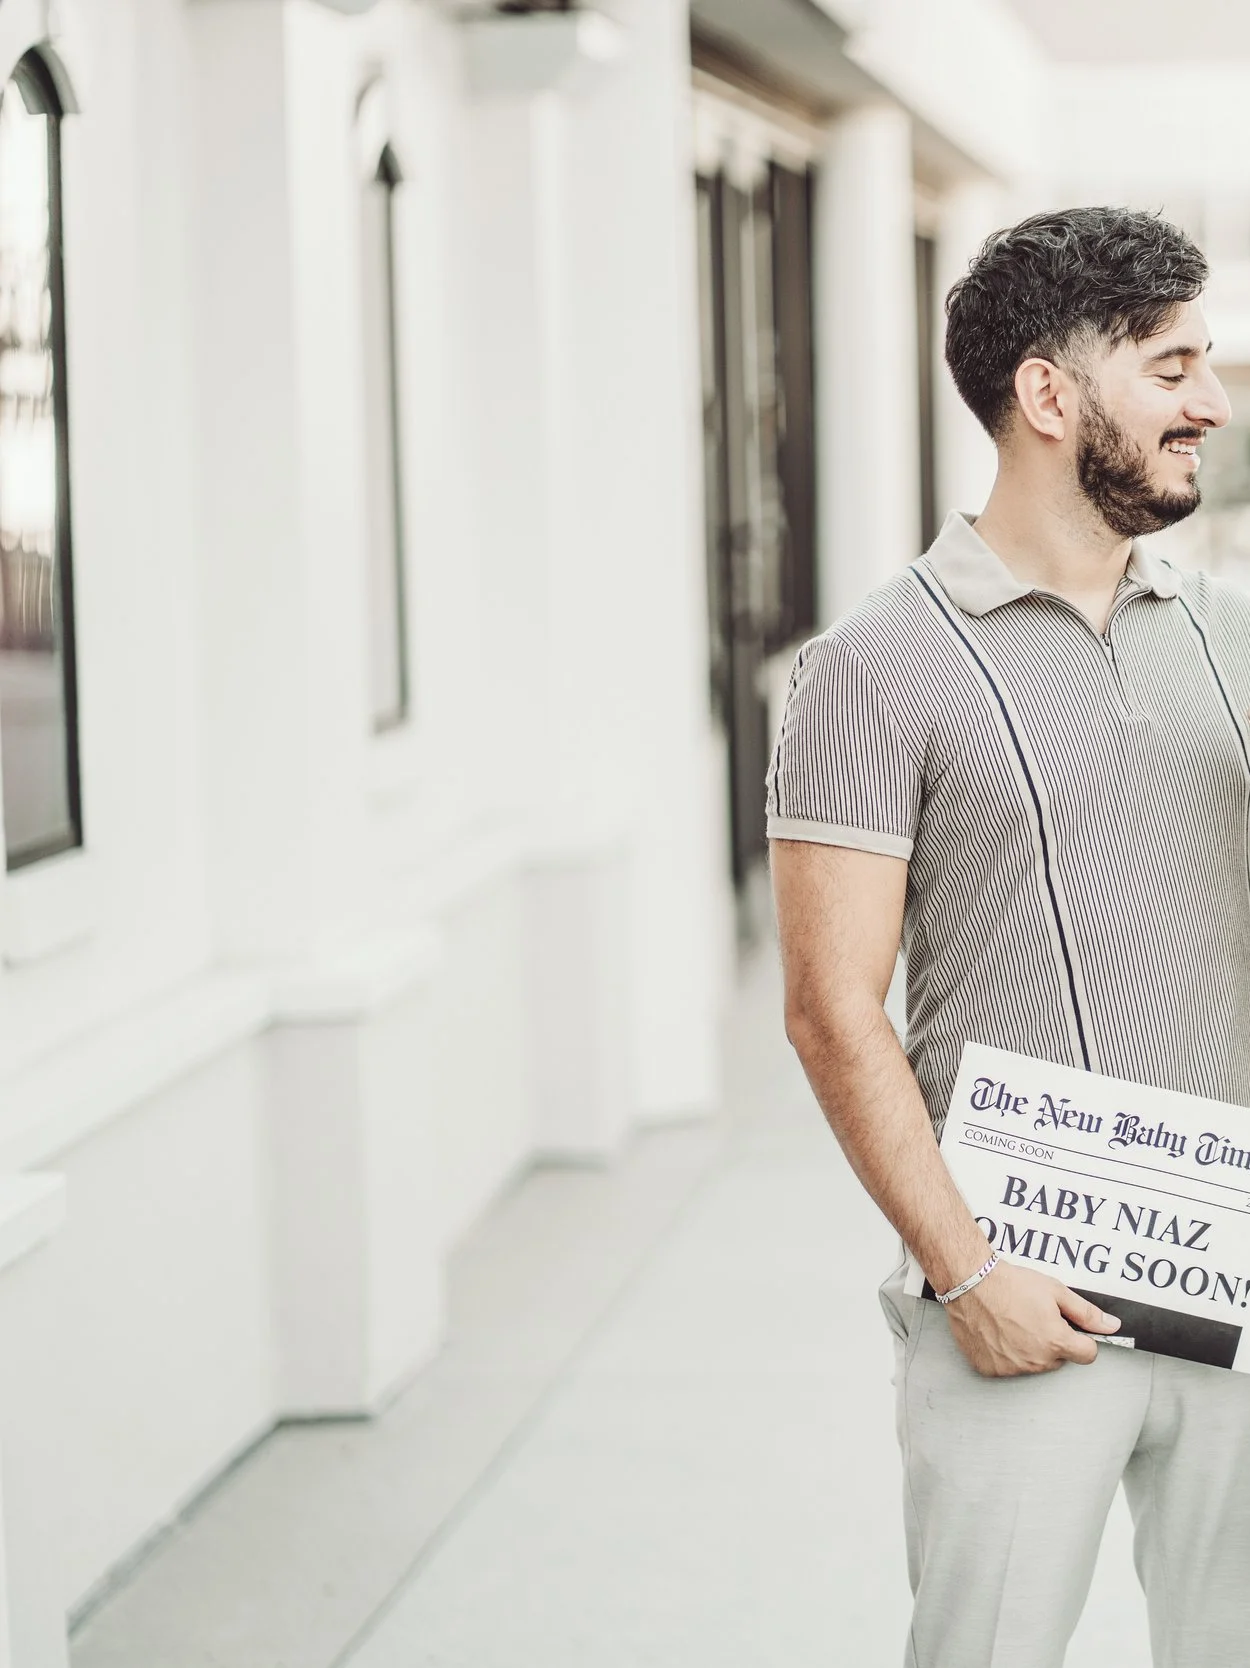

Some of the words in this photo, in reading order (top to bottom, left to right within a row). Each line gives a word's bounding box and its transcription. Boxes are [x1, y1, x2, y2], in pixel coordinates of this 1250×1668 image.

[965, 1128, 1016, 1151] COMING
[1018, 1141, 1054, 1160] SOON
[971, 1077, 1029, 1117] The
[1033, 1093, 1103, 1133] New
[1108, 1112, 1187, 1158] Baby
[974, 1216, 1112, 1274] OMING
[1000, 1175, 1107, 1226] BABY
[1112, 1202, 1212, 1252] NIAZ
